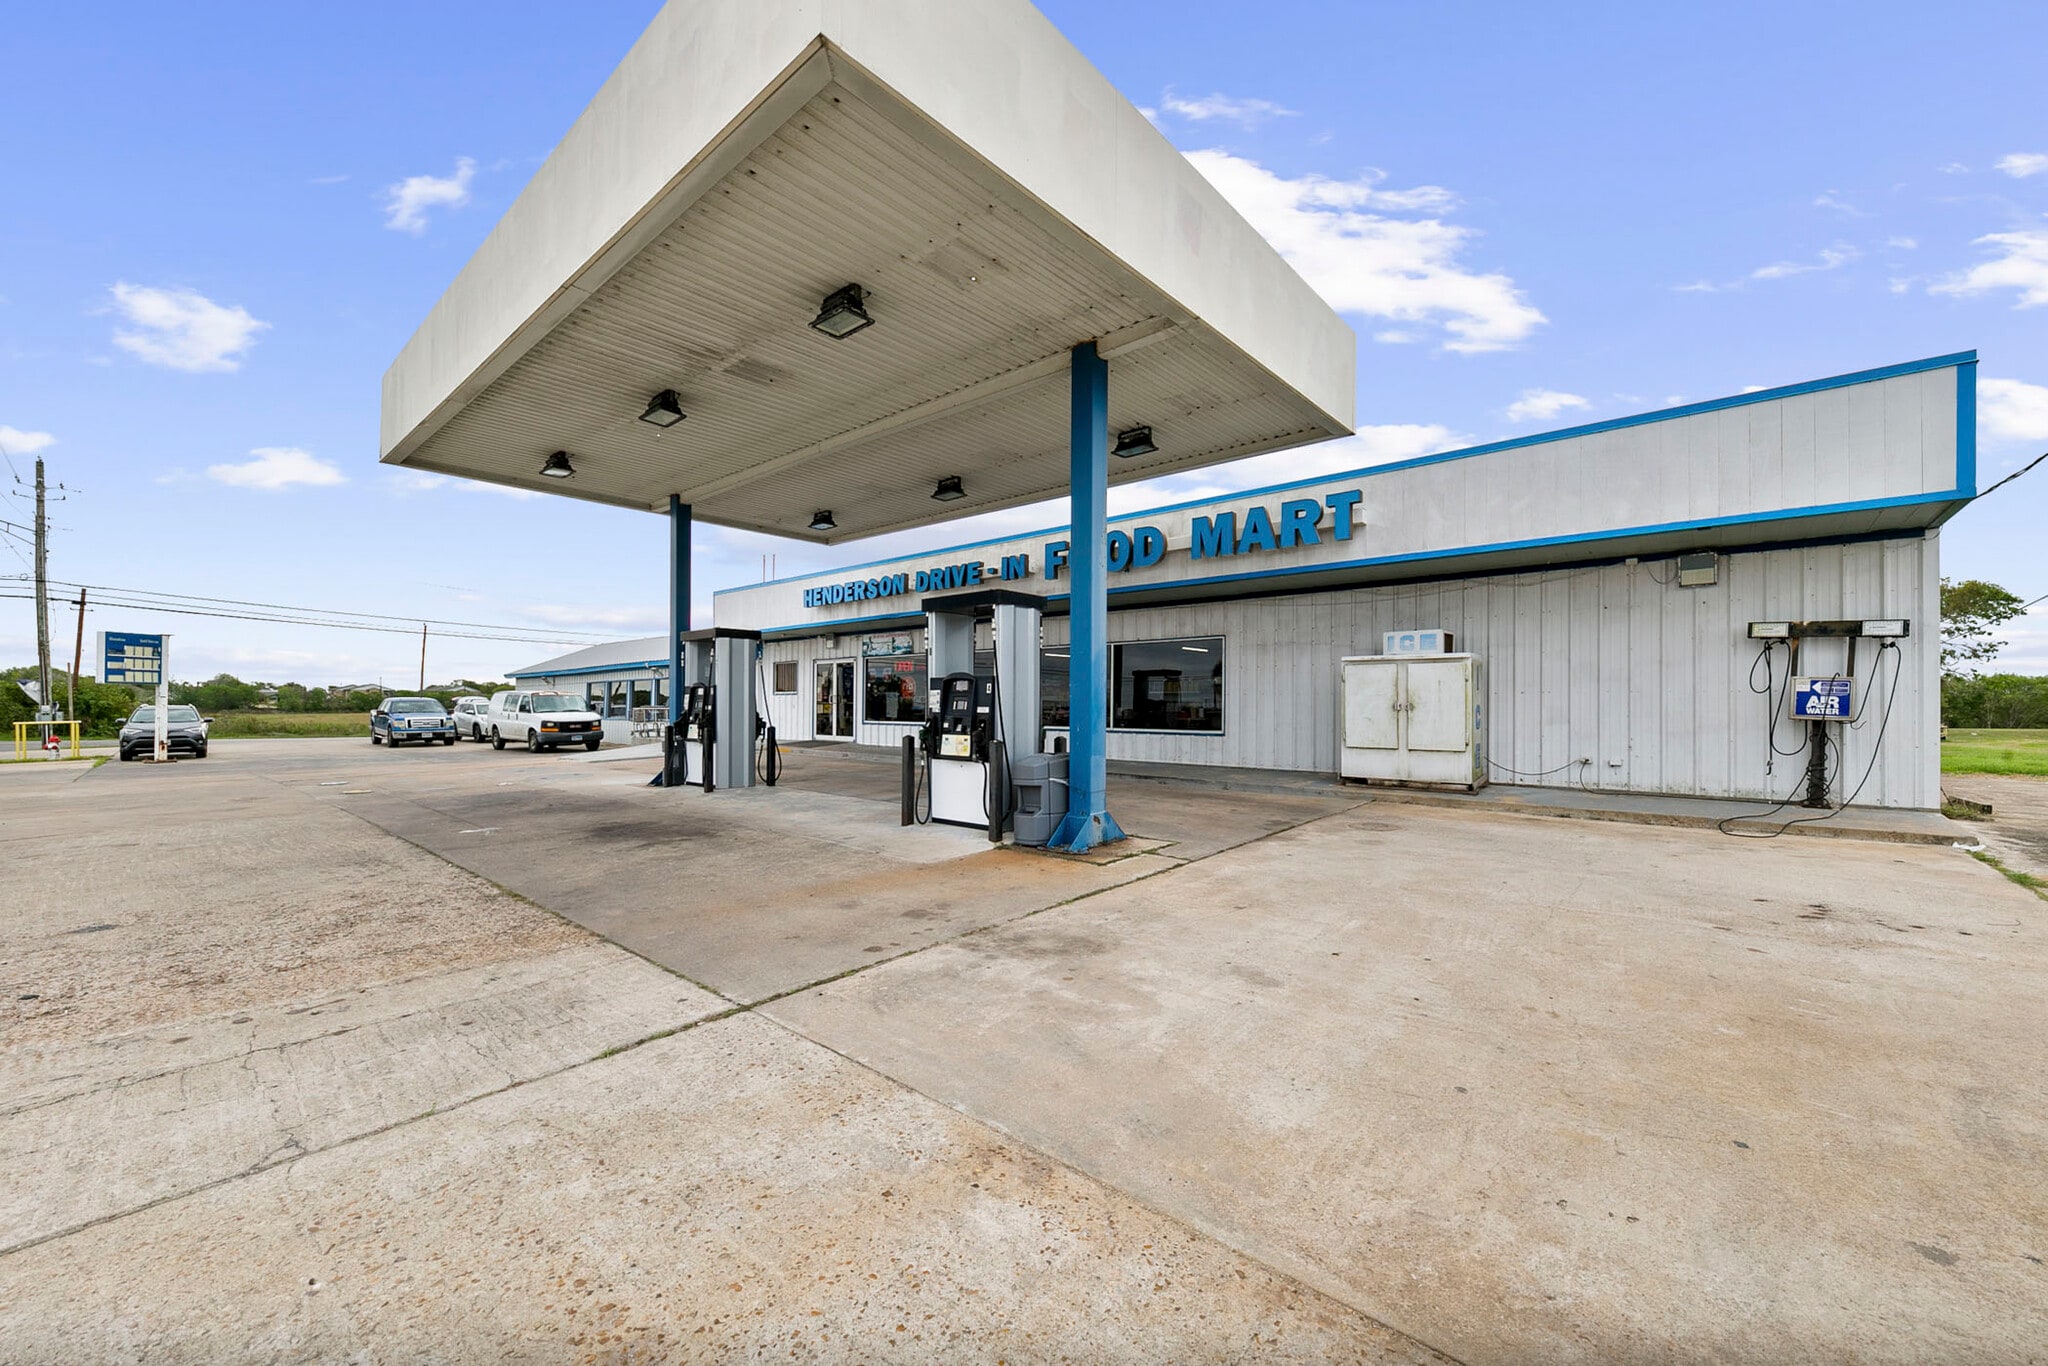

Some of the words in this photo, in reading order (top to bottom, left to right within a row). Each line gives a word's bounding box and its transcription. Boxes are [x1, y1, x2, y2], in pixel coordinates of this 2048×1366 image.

[1044, 525, 1168, 580] FOD
[1190, 489, 1364, 561] MART
[803, 573, 909, 608] HENDERSON
[1387, 633, 1438, 651] ICE
[1806, 695, 1840, 708] AIR
